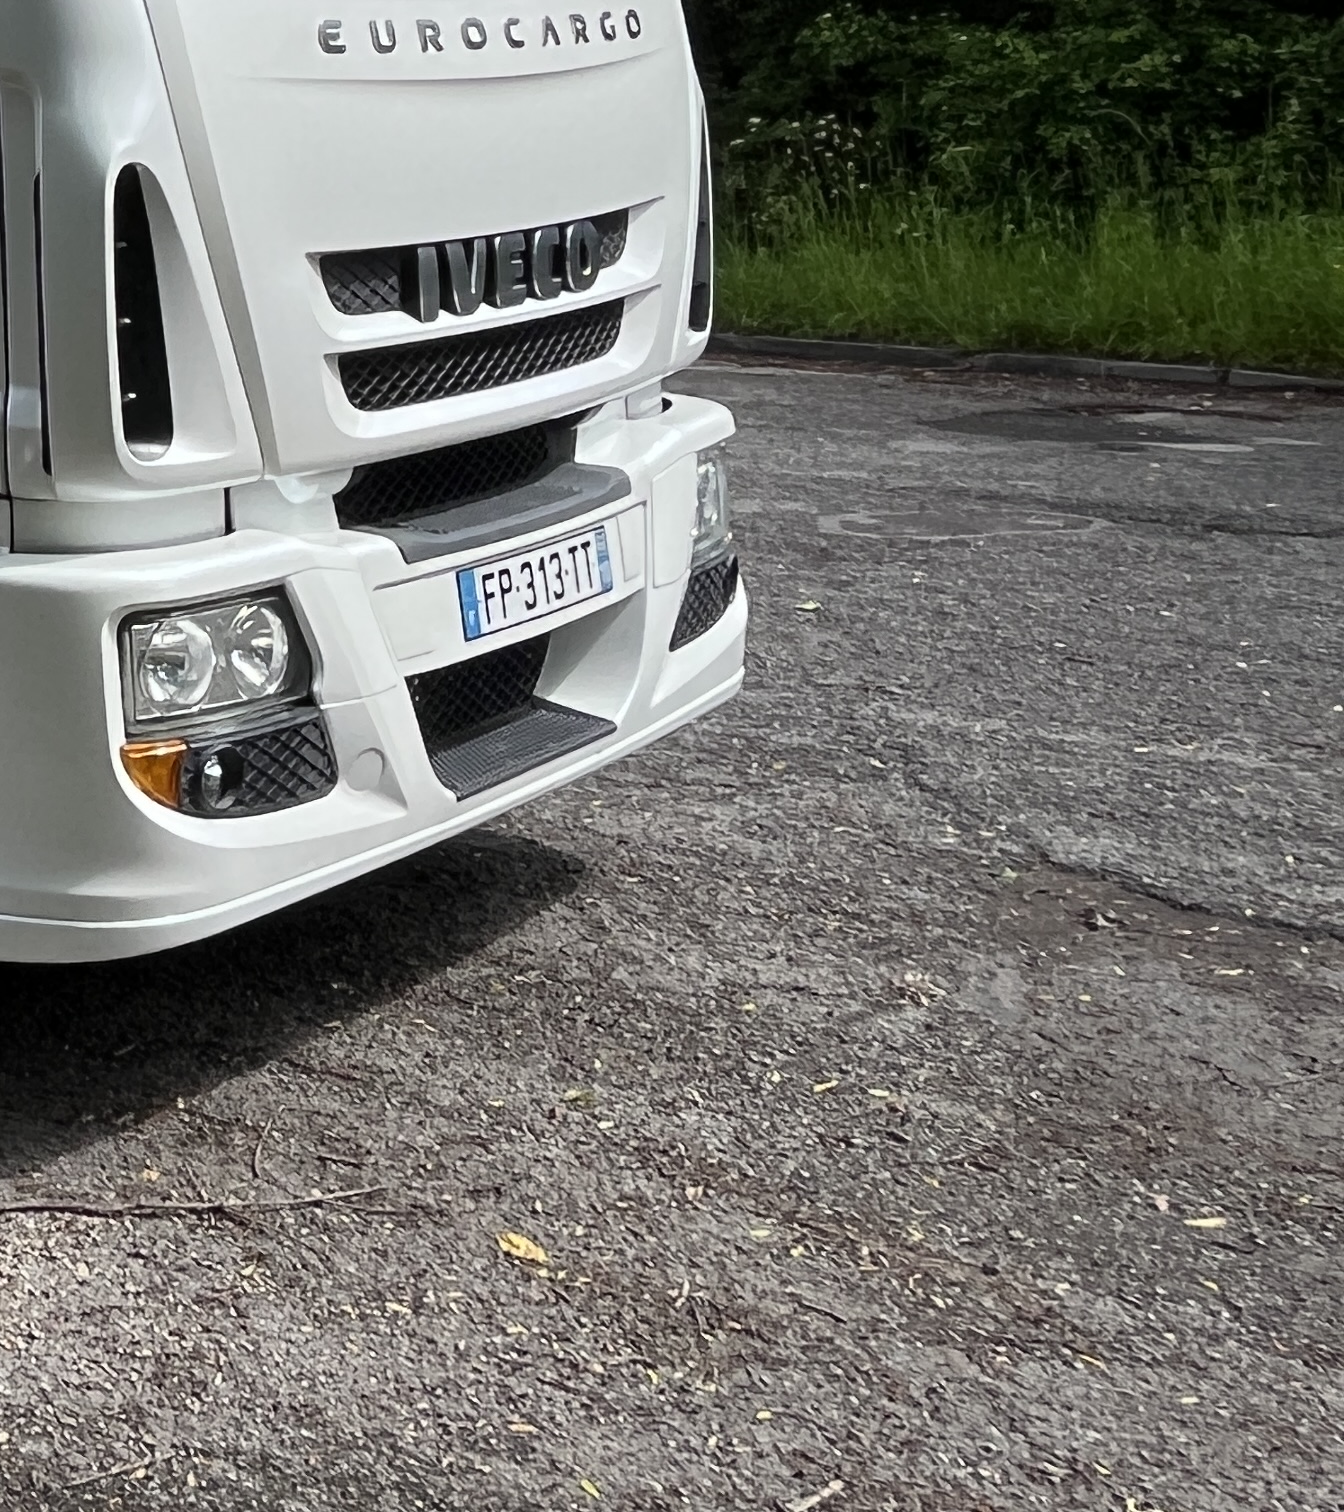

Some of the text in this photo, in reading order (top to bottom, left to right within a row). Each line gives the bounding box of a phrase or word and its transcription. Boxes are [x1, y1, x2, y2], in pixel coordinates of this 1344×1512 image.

[317, 9, 642, 54] EUROCARGO
[417, 220, 601, 323] IVECO
[481, 540, 592, 625] FP-313-TT
